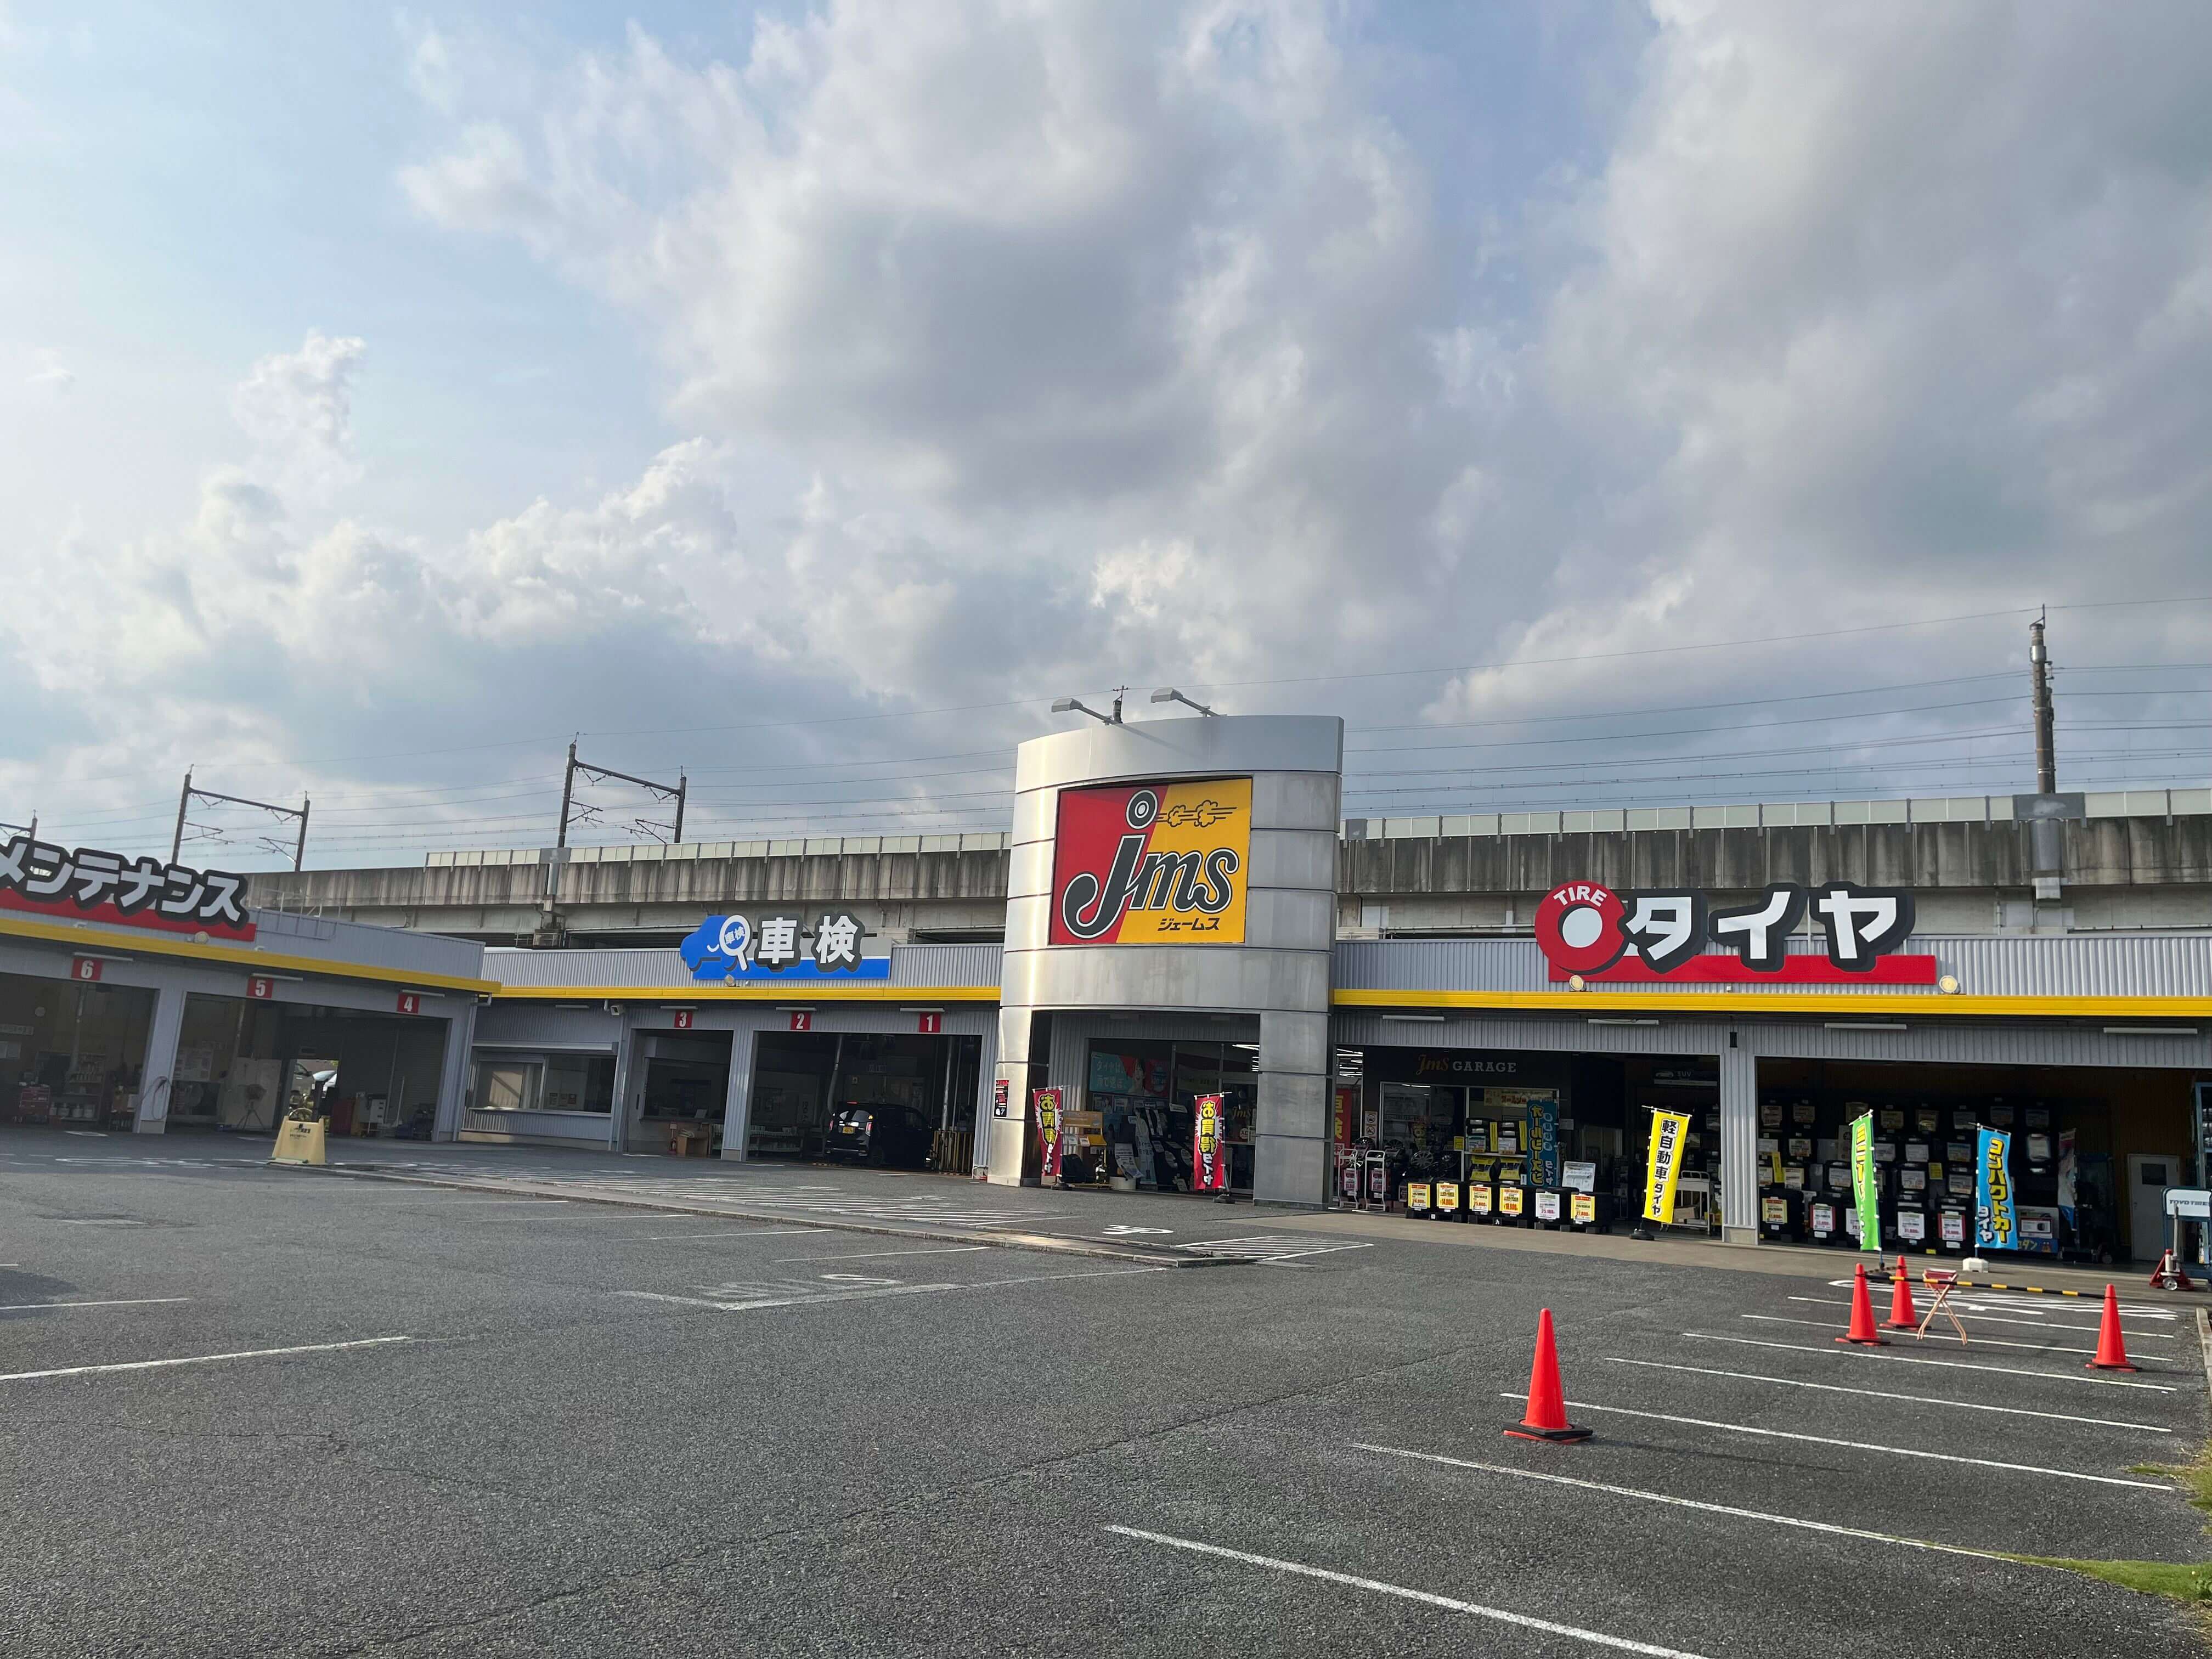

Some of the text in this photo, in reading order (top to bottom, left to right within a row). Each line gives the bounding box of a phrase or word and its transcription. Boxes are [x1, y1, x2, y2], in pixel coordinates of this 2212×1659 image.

[0, 843, 240, 923] メンテナンス
[1553, 885, 1607, 907] TIRE
[1158, 917, 1219, 932] ジェームス
[1626, 890, 1897, 961] タイヤ
[724, 926, 745, 945] 車検
[758, 915, 859, 964] 車検
[81, 960, 93, 979] 6
[256, 980, 266, 997] 5
[403, 996, 413, 1012] 4
[679, 1012, 687, 1028] 3
[796, 1013, 804, 1029] 2
[926, 1015, 934, 1031] 1
[1453, 1061, 1516, 1073] GARAGE
[1988, 1139, 2010, 1242] コンパクトカー
[1979, 1206, 1993, 1242] タイヤ
